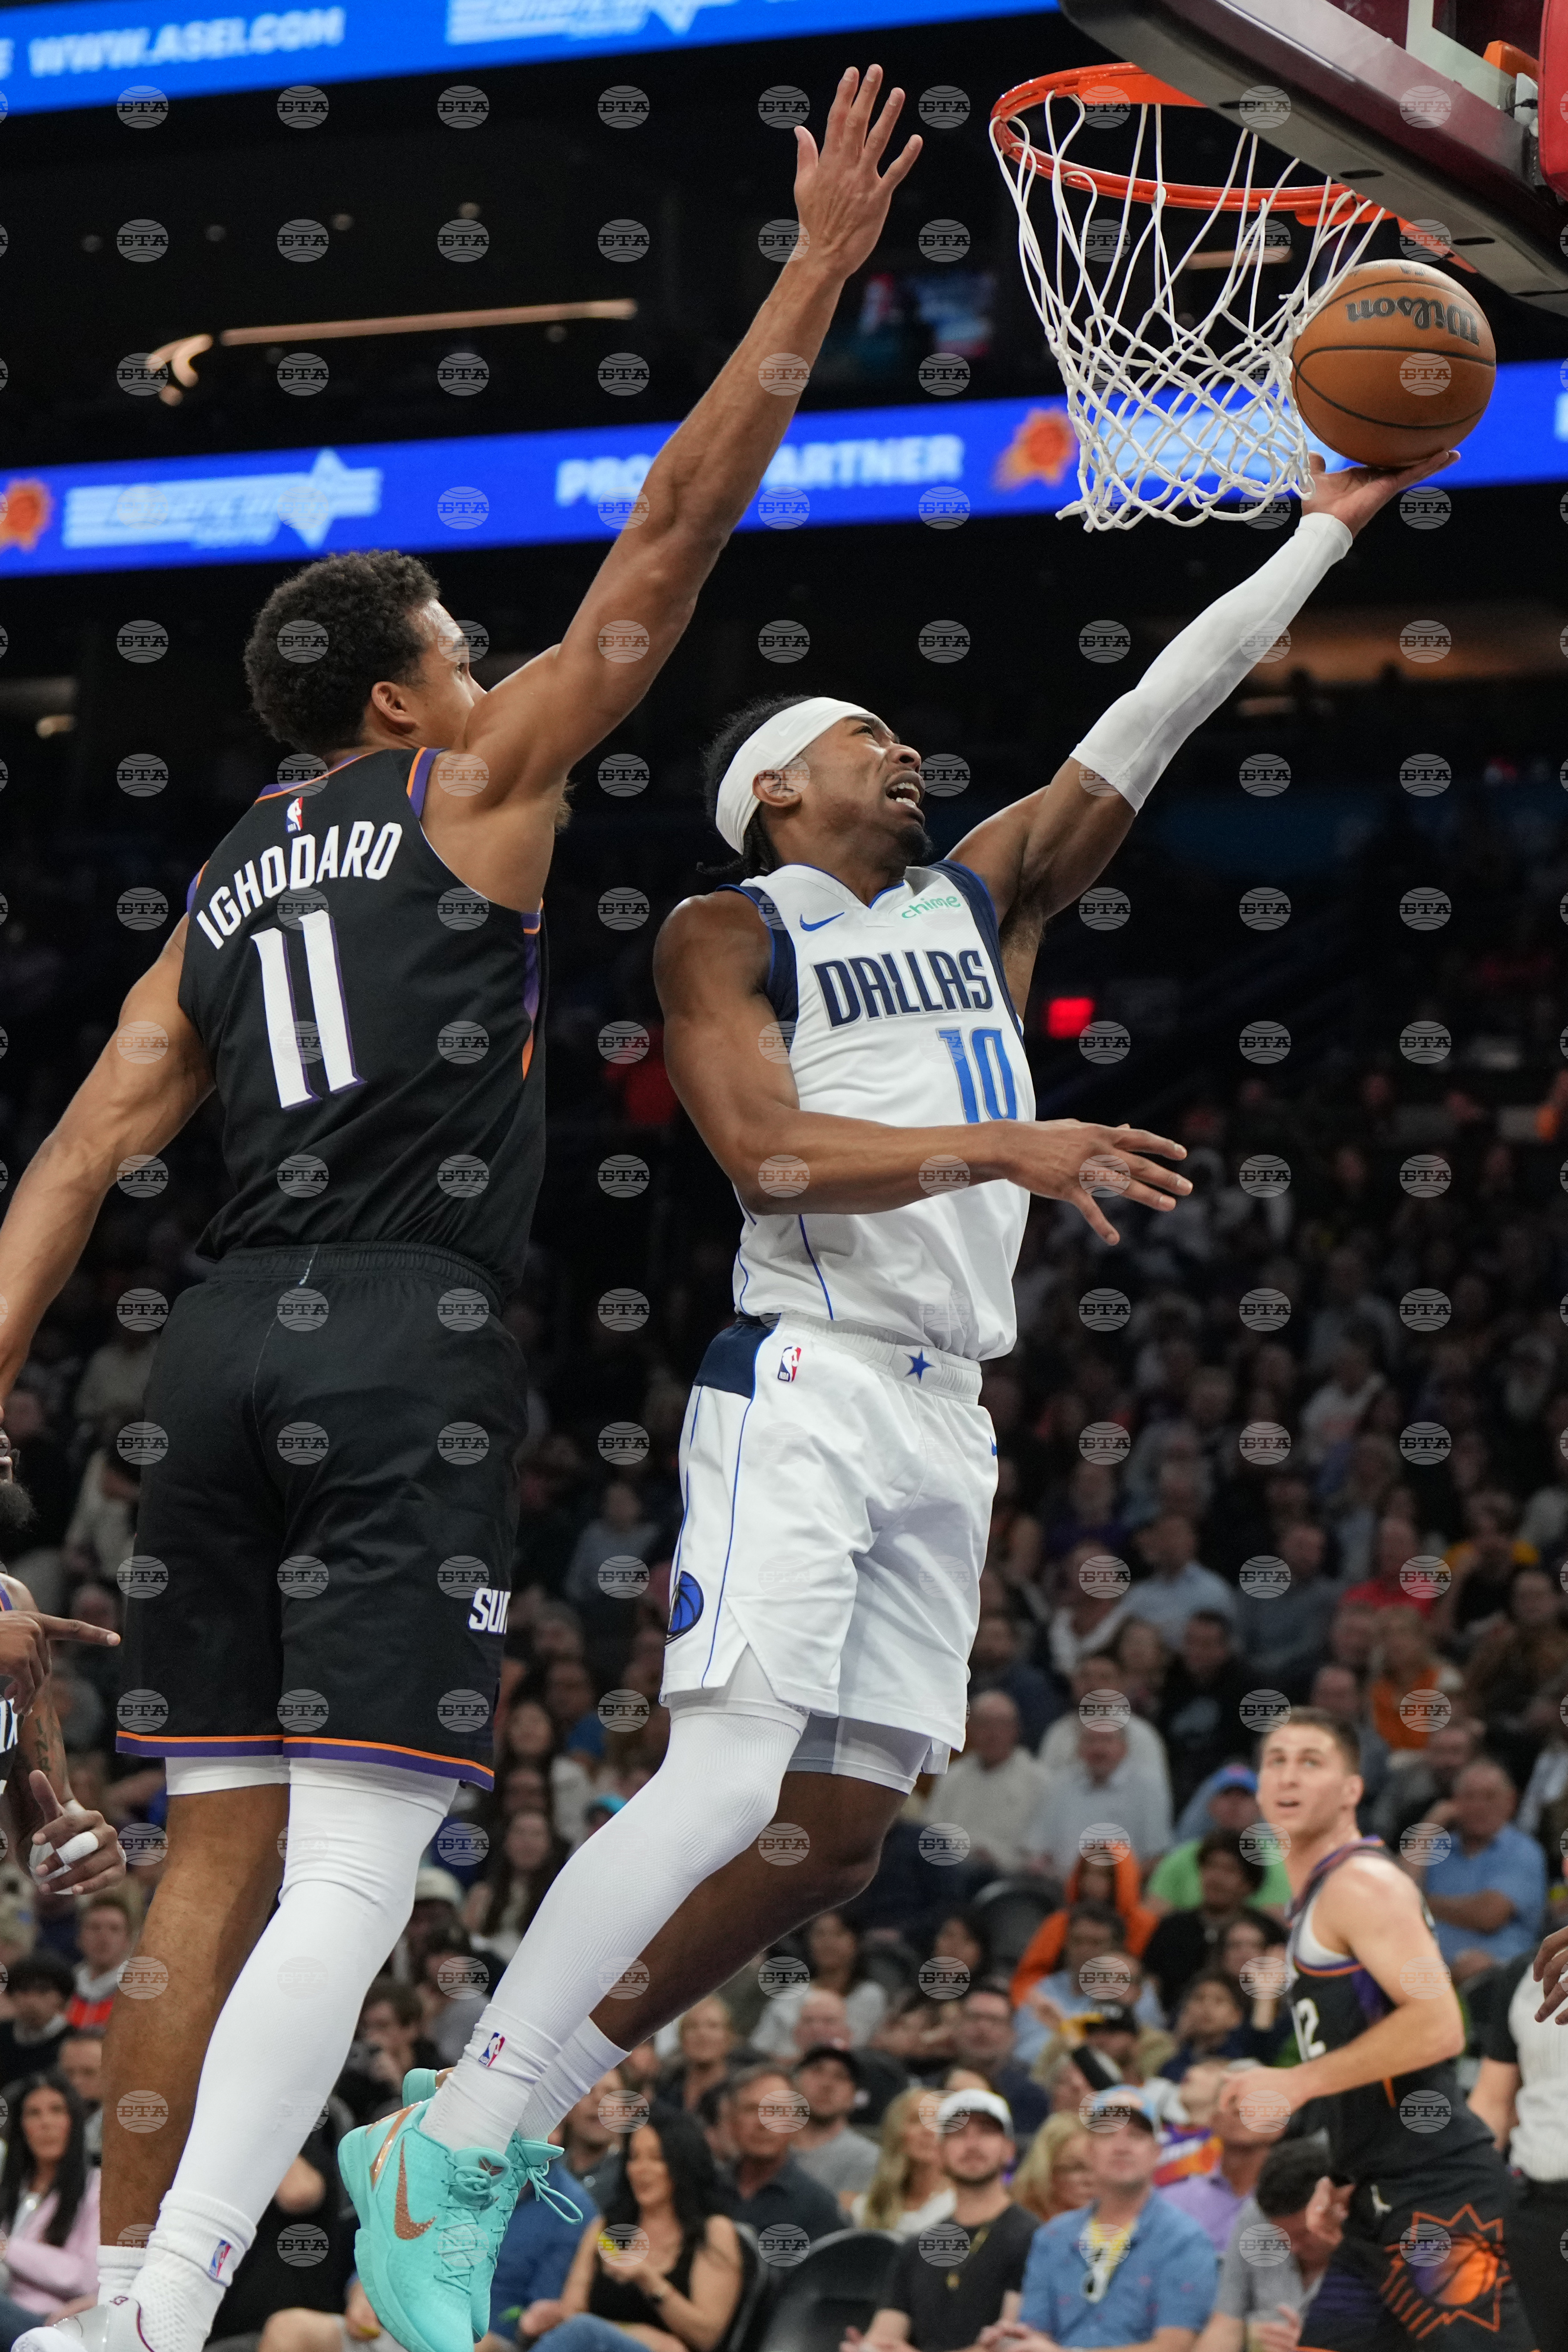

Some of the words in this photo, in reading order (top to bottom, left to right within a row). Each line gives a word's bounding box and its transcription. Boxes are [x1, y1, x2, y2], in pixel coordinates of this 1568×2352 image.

[1345, 296, 1479, 347] Wilson
[555, 453, 660, 507] PRO
[760, 433, 966, 492] ARTNER
[196, 821, 403, 950] IGHODARO
[901, 896, 961, 918] chime
[250, 909, 367, 1110] 11
[810, 948, 994, 1031] DALLAS
[935, 1026, 1017, 1124] 10
